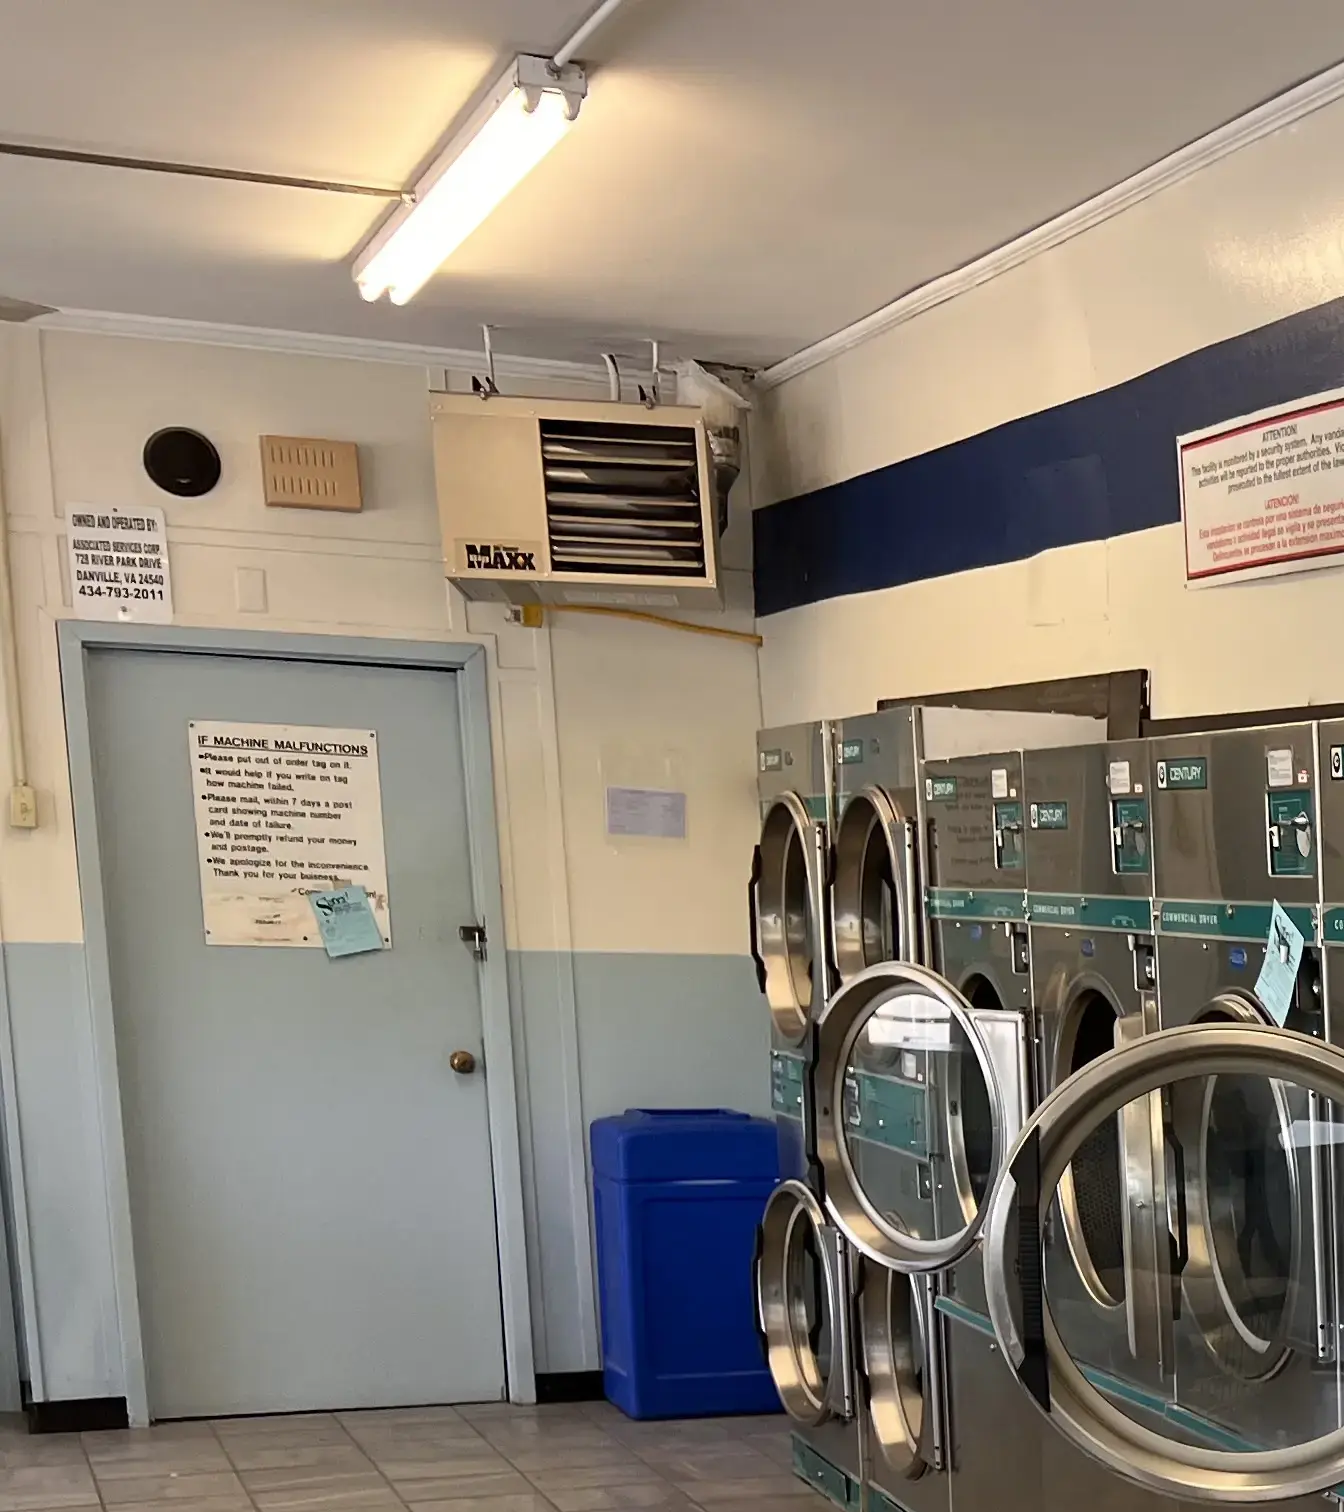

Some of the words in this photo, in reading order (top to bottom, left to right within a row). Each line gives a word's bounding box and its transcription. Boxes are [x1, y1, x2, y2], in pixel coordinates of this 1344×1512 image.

[97, 515, 110, 529] AND
[111, 516, 145, 531] OPERATED
[112, 541, 142, 554] SERVICES
[91, 554, 115, 566] RIVER
[116, 556, 137, 567] PARK
[138, 557, 162, 569] DRIVE
[76, 569, 123, 585] DANVILLE,
[124, 572, 137, 584] VA
[138, 573, 164, 586] 24540
[78, 585, 163, 601] 434-793-2011
[197, 735, 210, 746] IF
[213, 736, 269, 750] MACHINE
[274, 739, 368, 755] MALFUNCTIONS
[203, 752, 234, 762] Please
[237, 755, 252, 764] put
[272, 757, 282, 765] of
[285, 758, 308, 767] order
[311, 759, 327, 770] tag
[1170, 766, 1202, 781] CENTURY
[1162, 912, 1197, 924] COMMERCIAL
[1199, 914, 1218, 925] DRYER
